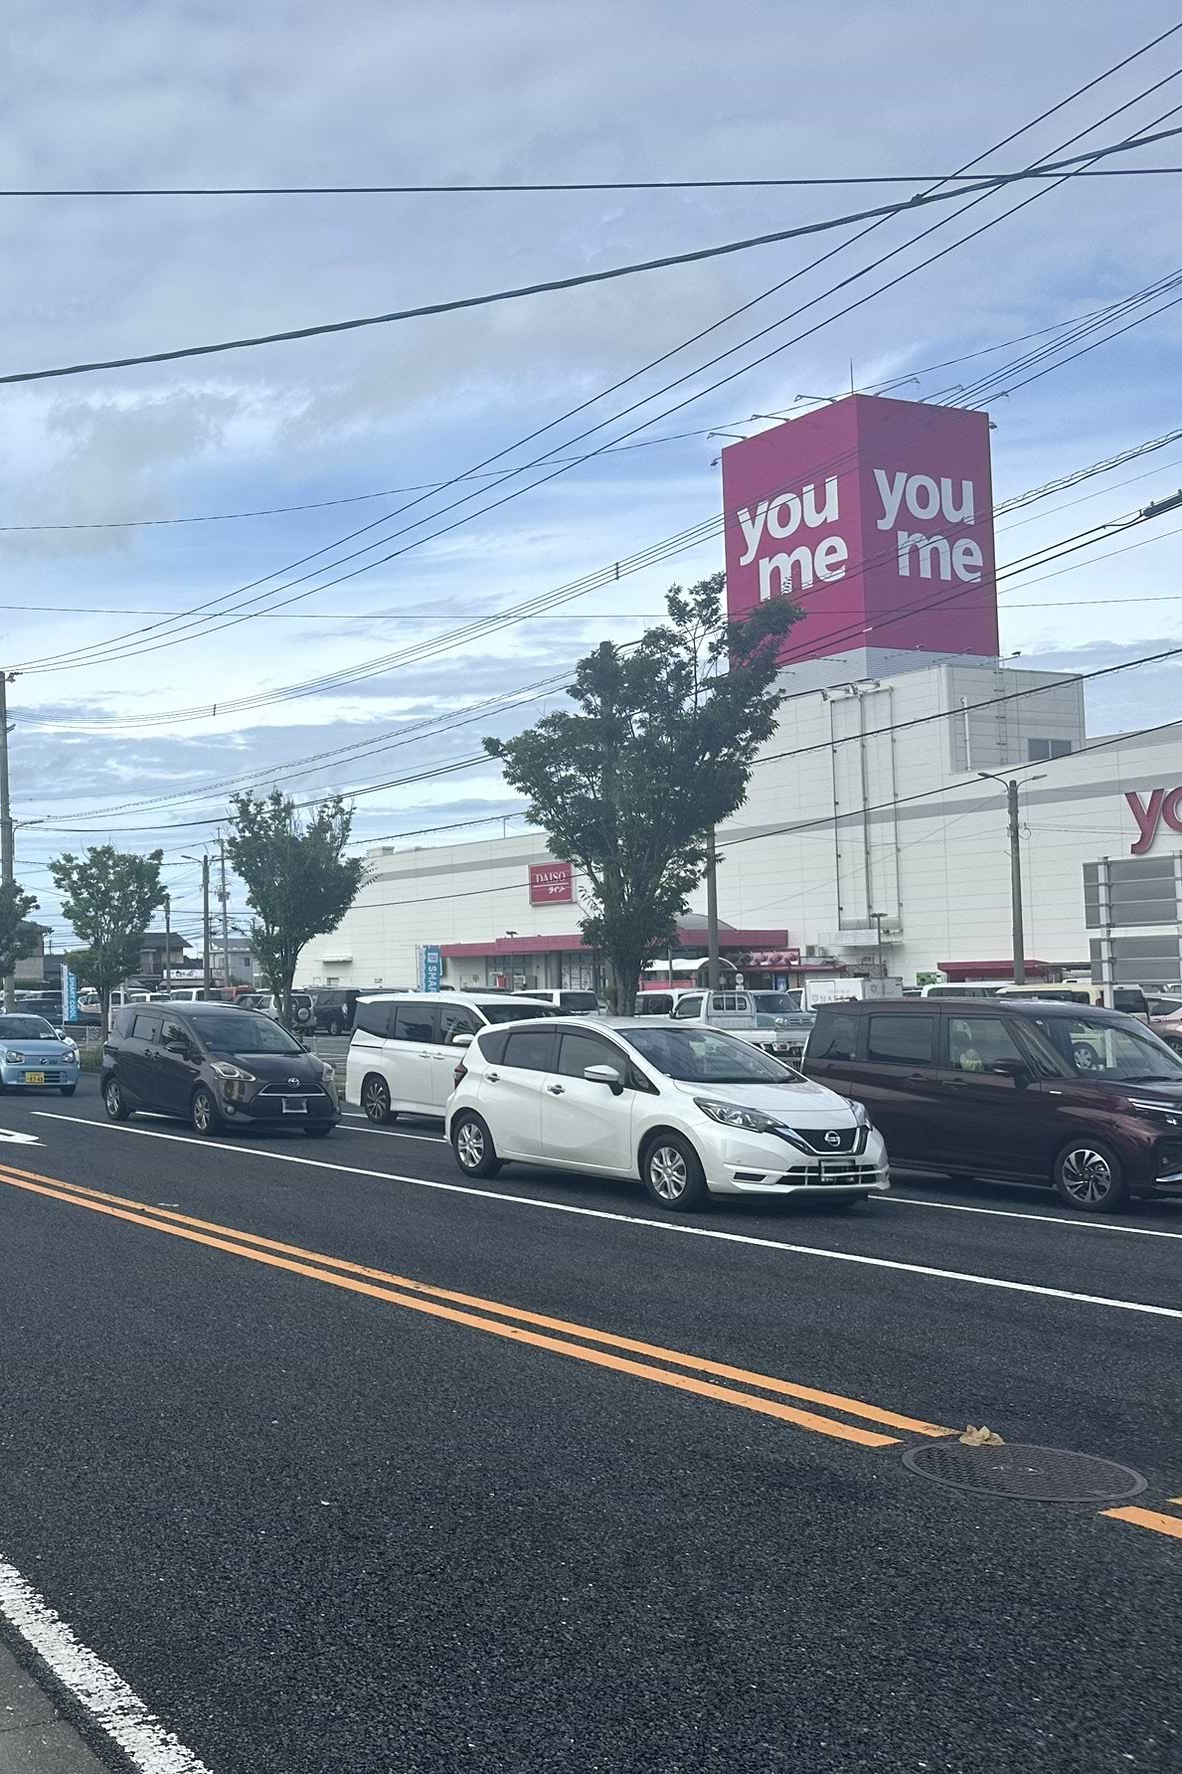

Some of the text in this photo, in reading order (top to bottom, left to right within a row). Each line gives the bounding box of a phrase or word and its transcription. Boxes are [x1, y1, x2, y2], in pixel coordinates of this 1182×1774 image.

[737, 475, 839, 566] you
[873, 468, 975, 531] you
[758, 536, 848, 602] me
[897, 530, 984, 584] me
[535, 871, 566, 884] DAISO
[427, 965, 437, 992] SMAR
